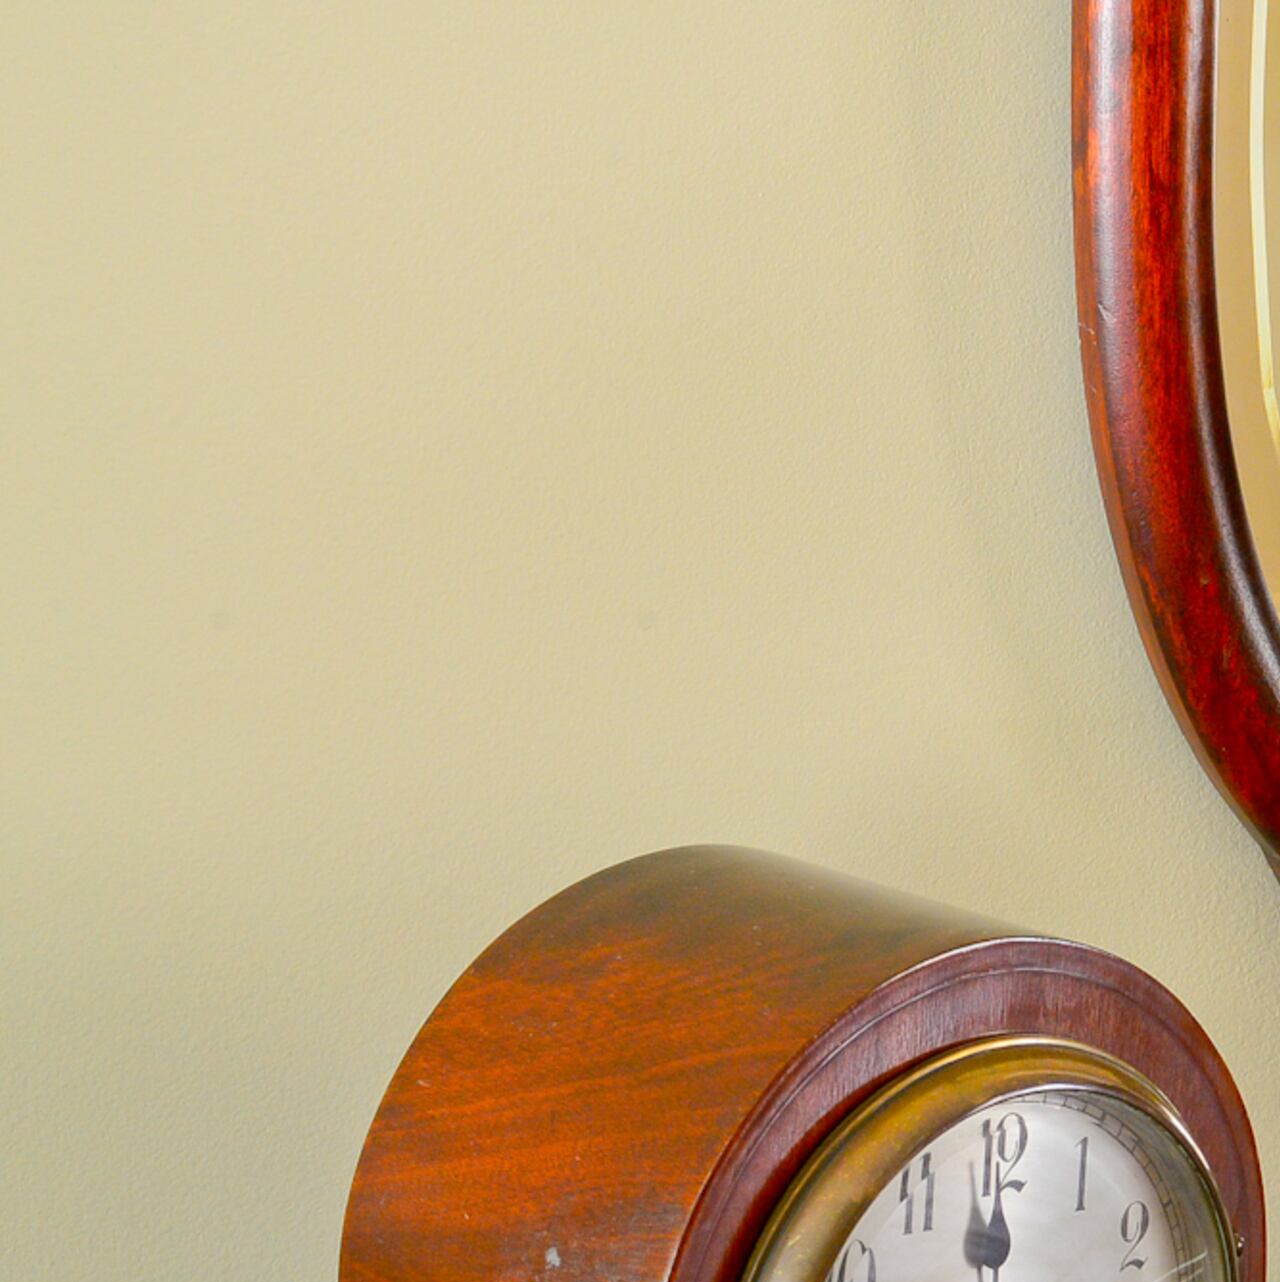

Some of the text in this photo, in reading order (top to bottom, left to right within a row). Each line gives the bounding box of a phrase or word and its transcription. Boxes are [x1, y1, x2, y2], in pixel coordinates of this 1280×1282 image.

[899, 1151, 936, 1235] 11
[981, 1111, 1029, 1198] 12
[1074, 1136, 1090, 1212] 1
[1119, 1200, 1150, 1272] 2
